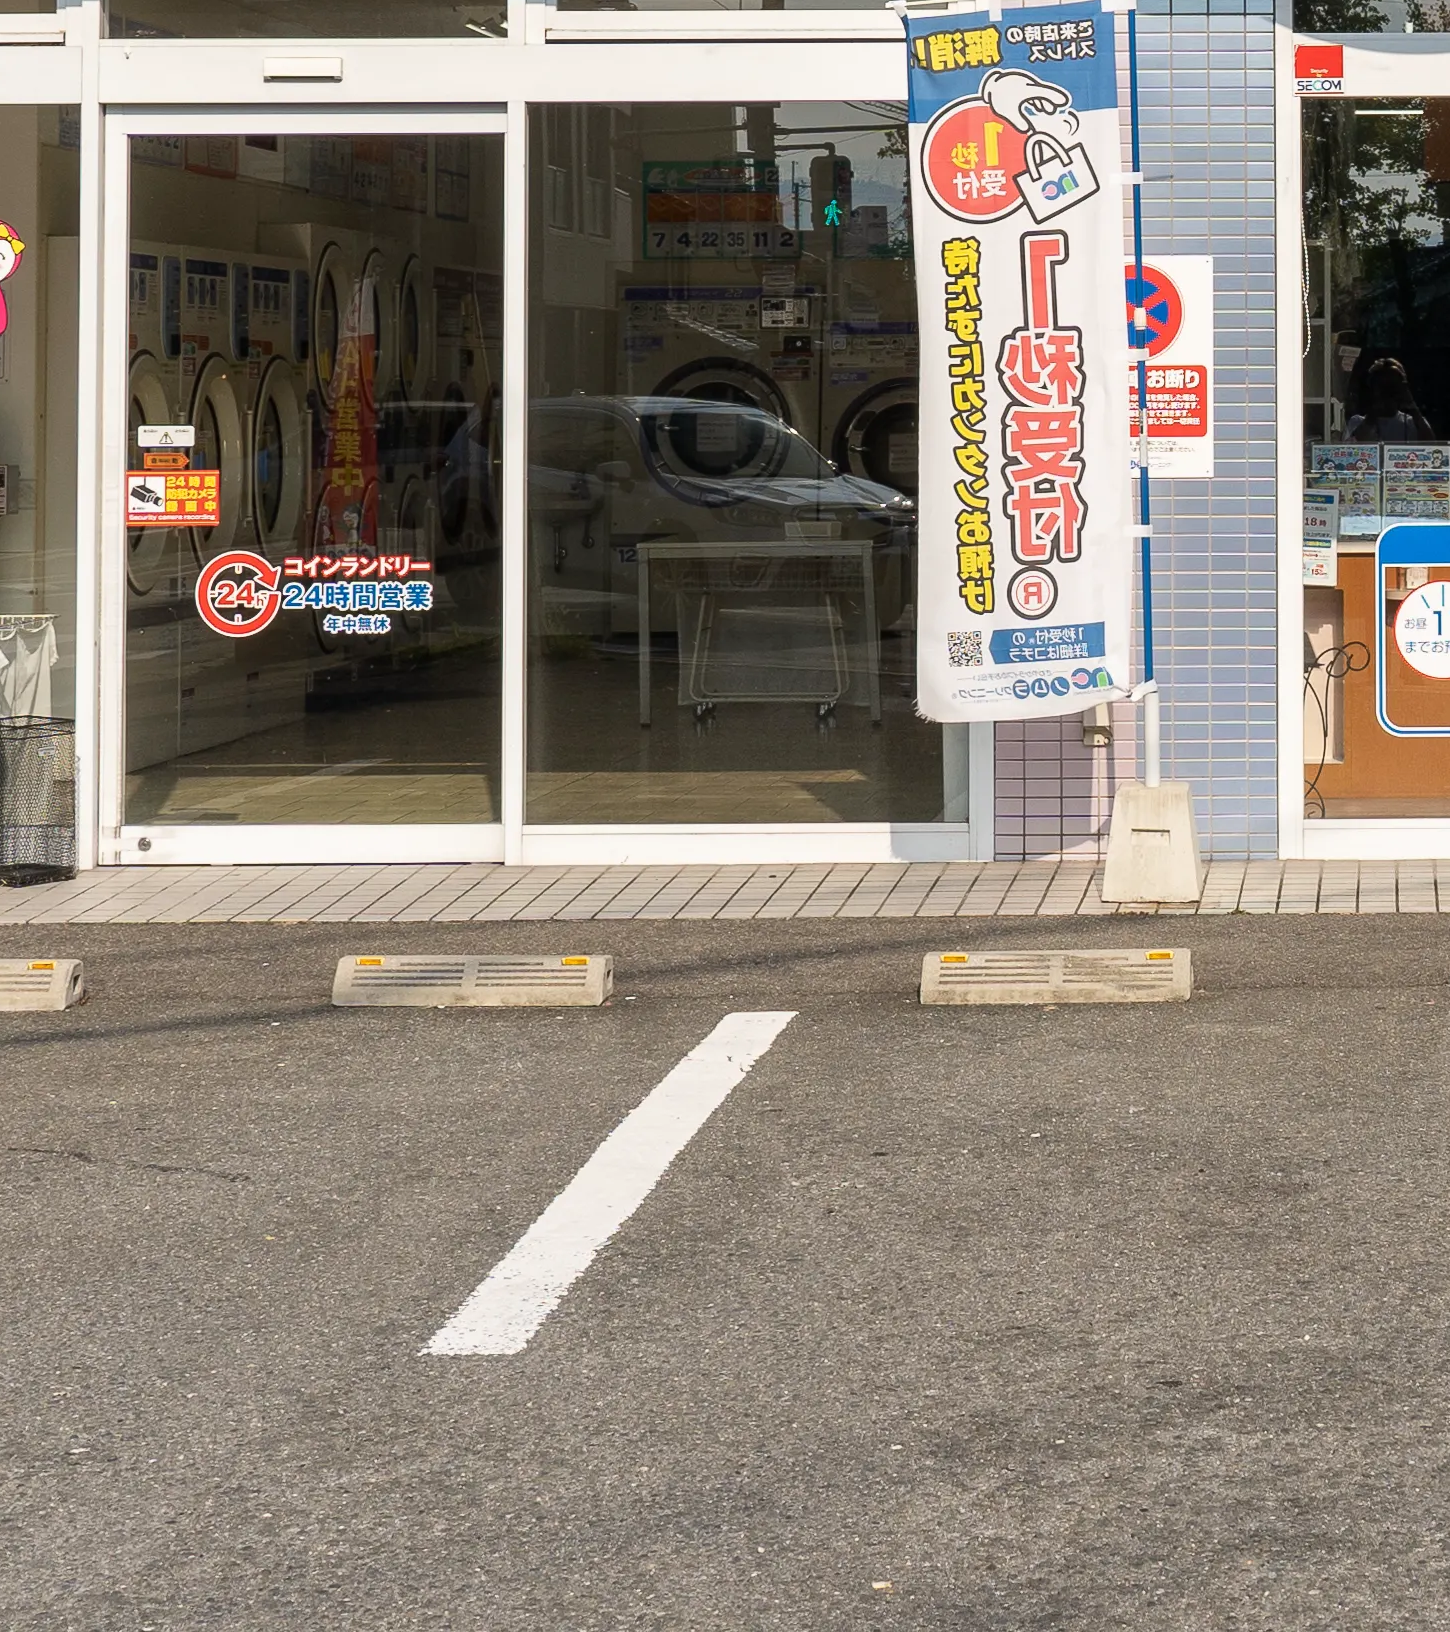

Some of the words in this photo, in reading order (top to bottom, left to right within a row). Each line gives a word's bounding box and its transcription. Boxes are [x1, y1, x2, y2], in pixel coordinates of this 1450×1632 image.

[1297, 79, 1342, 91] SECOM
[652, 232, 666, 247] 7
[677, 232, 692, 247] 4
[701, 232, 718, 247] 22
[727, 232, 745, 247] 35
[753, 231, 768, 247] 11
[779, 231, 794, 247] 2
[166, 488, 216, 500] 防犯カメラ
[284, 555, 431, 577] コインランドリー
[283, 581, 433, 610] 24時間営業
[323, 614, 391, 633] 年中無休
[1404, 618, 1427, 630] お昼
